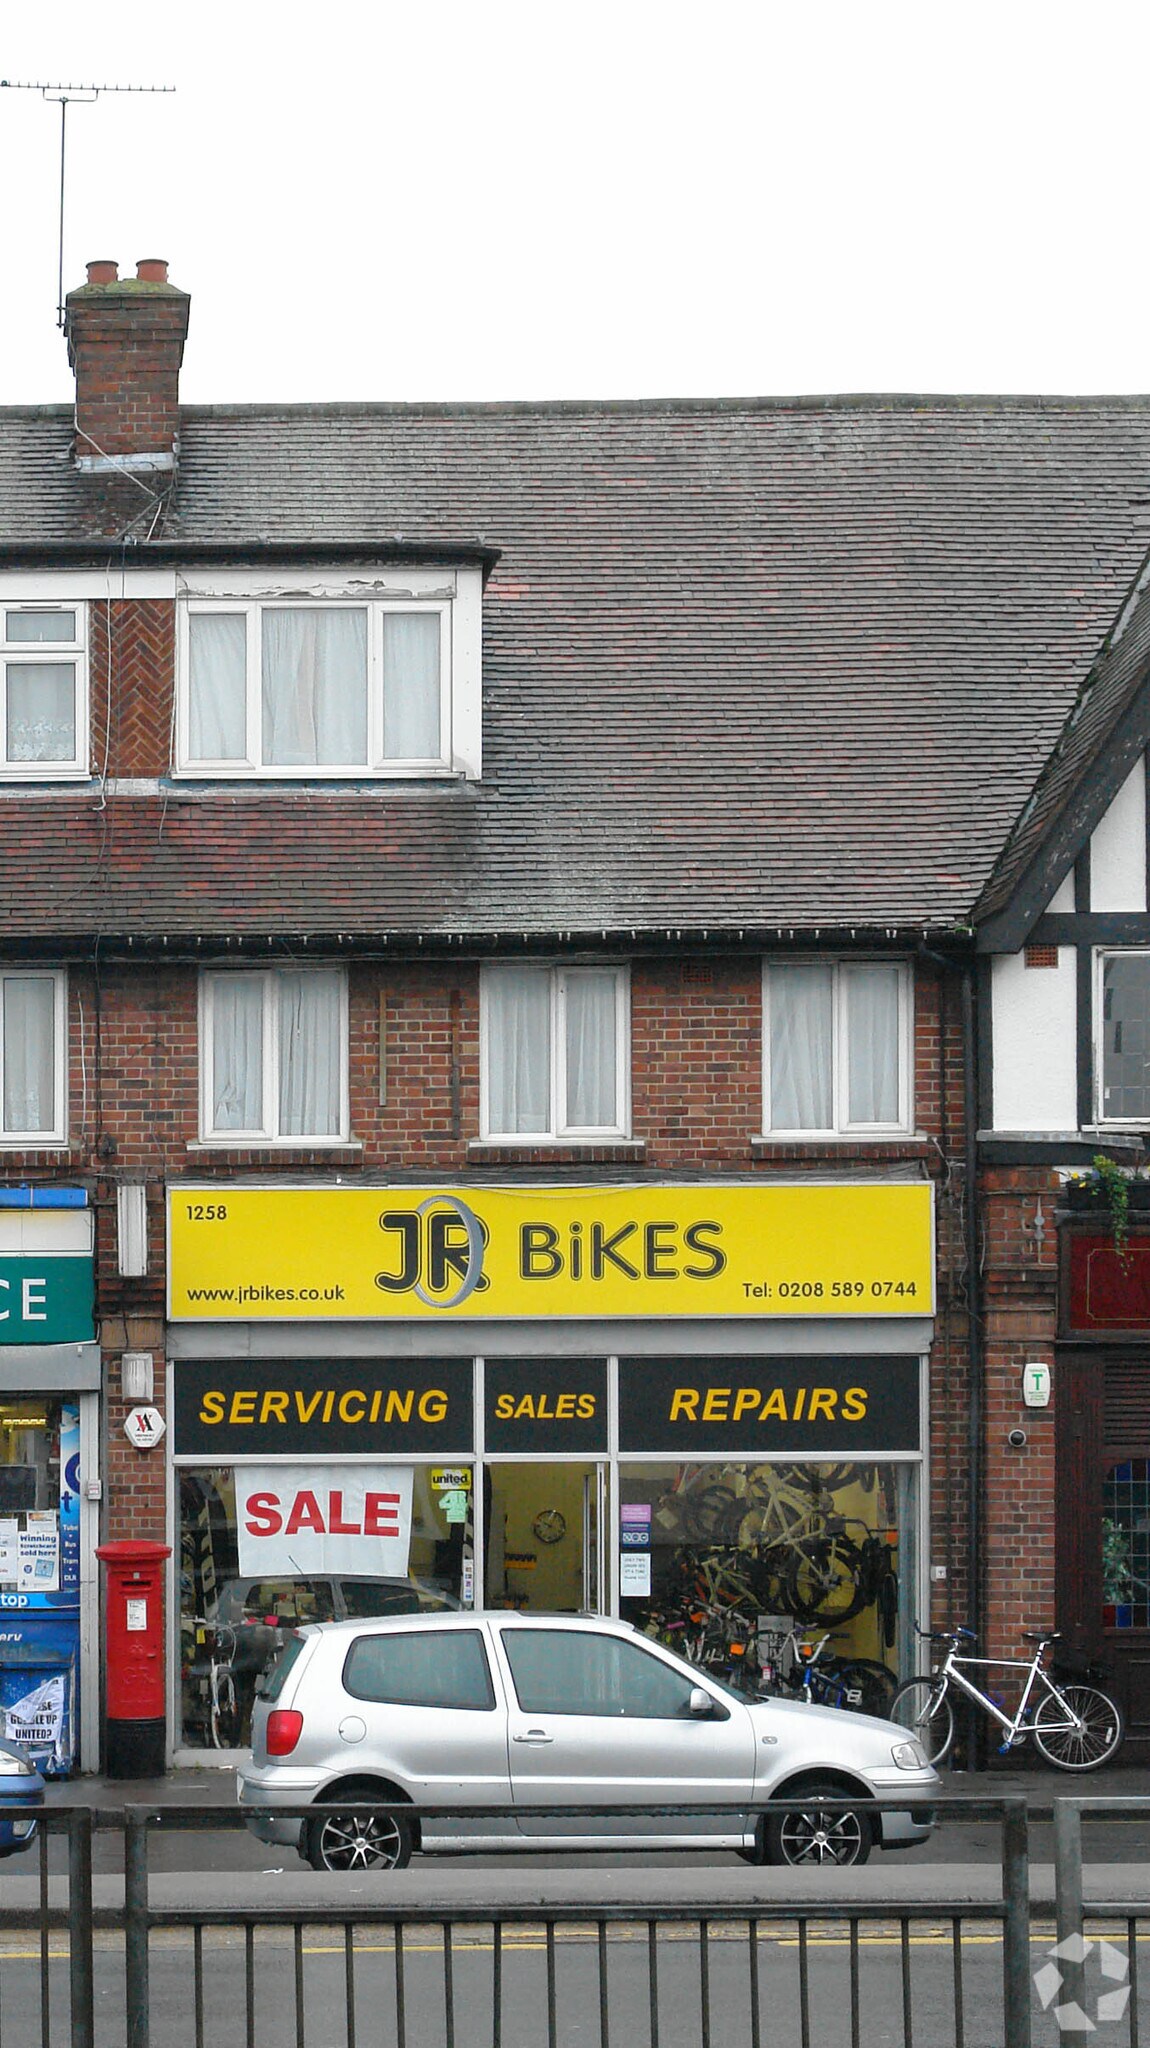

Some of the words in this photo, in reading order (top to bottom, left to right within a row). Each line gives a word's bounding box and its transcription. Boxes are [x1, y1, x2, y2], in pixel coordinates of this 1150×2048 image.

[186, 1205, 227, 1220] 1258
[374, 1210, 491, 1294] JR
[187, 1285, 345, 1304] www.jrbikes.co.uk
[742, 1283, 773, 1298] Tel:
[778, 1283, 824, 1298] 0208
[831, 1283, 864, 1298] 589
[871, 1282, 917, 1297] 0744
[199, 1390, 449, 1425] SERVICING
[494, 1393, 596, 1419] SALES
[669, 1387, 868, 1421] REPAIRS
[432, 1473, 468, 1484] united
[245, 1490, 401, 1537] SALE
[20, 1534, 57, 1543] Winning
[46, 1714, 57, 1725] UP
[15, 1728, 52, 1740] UNITED?
